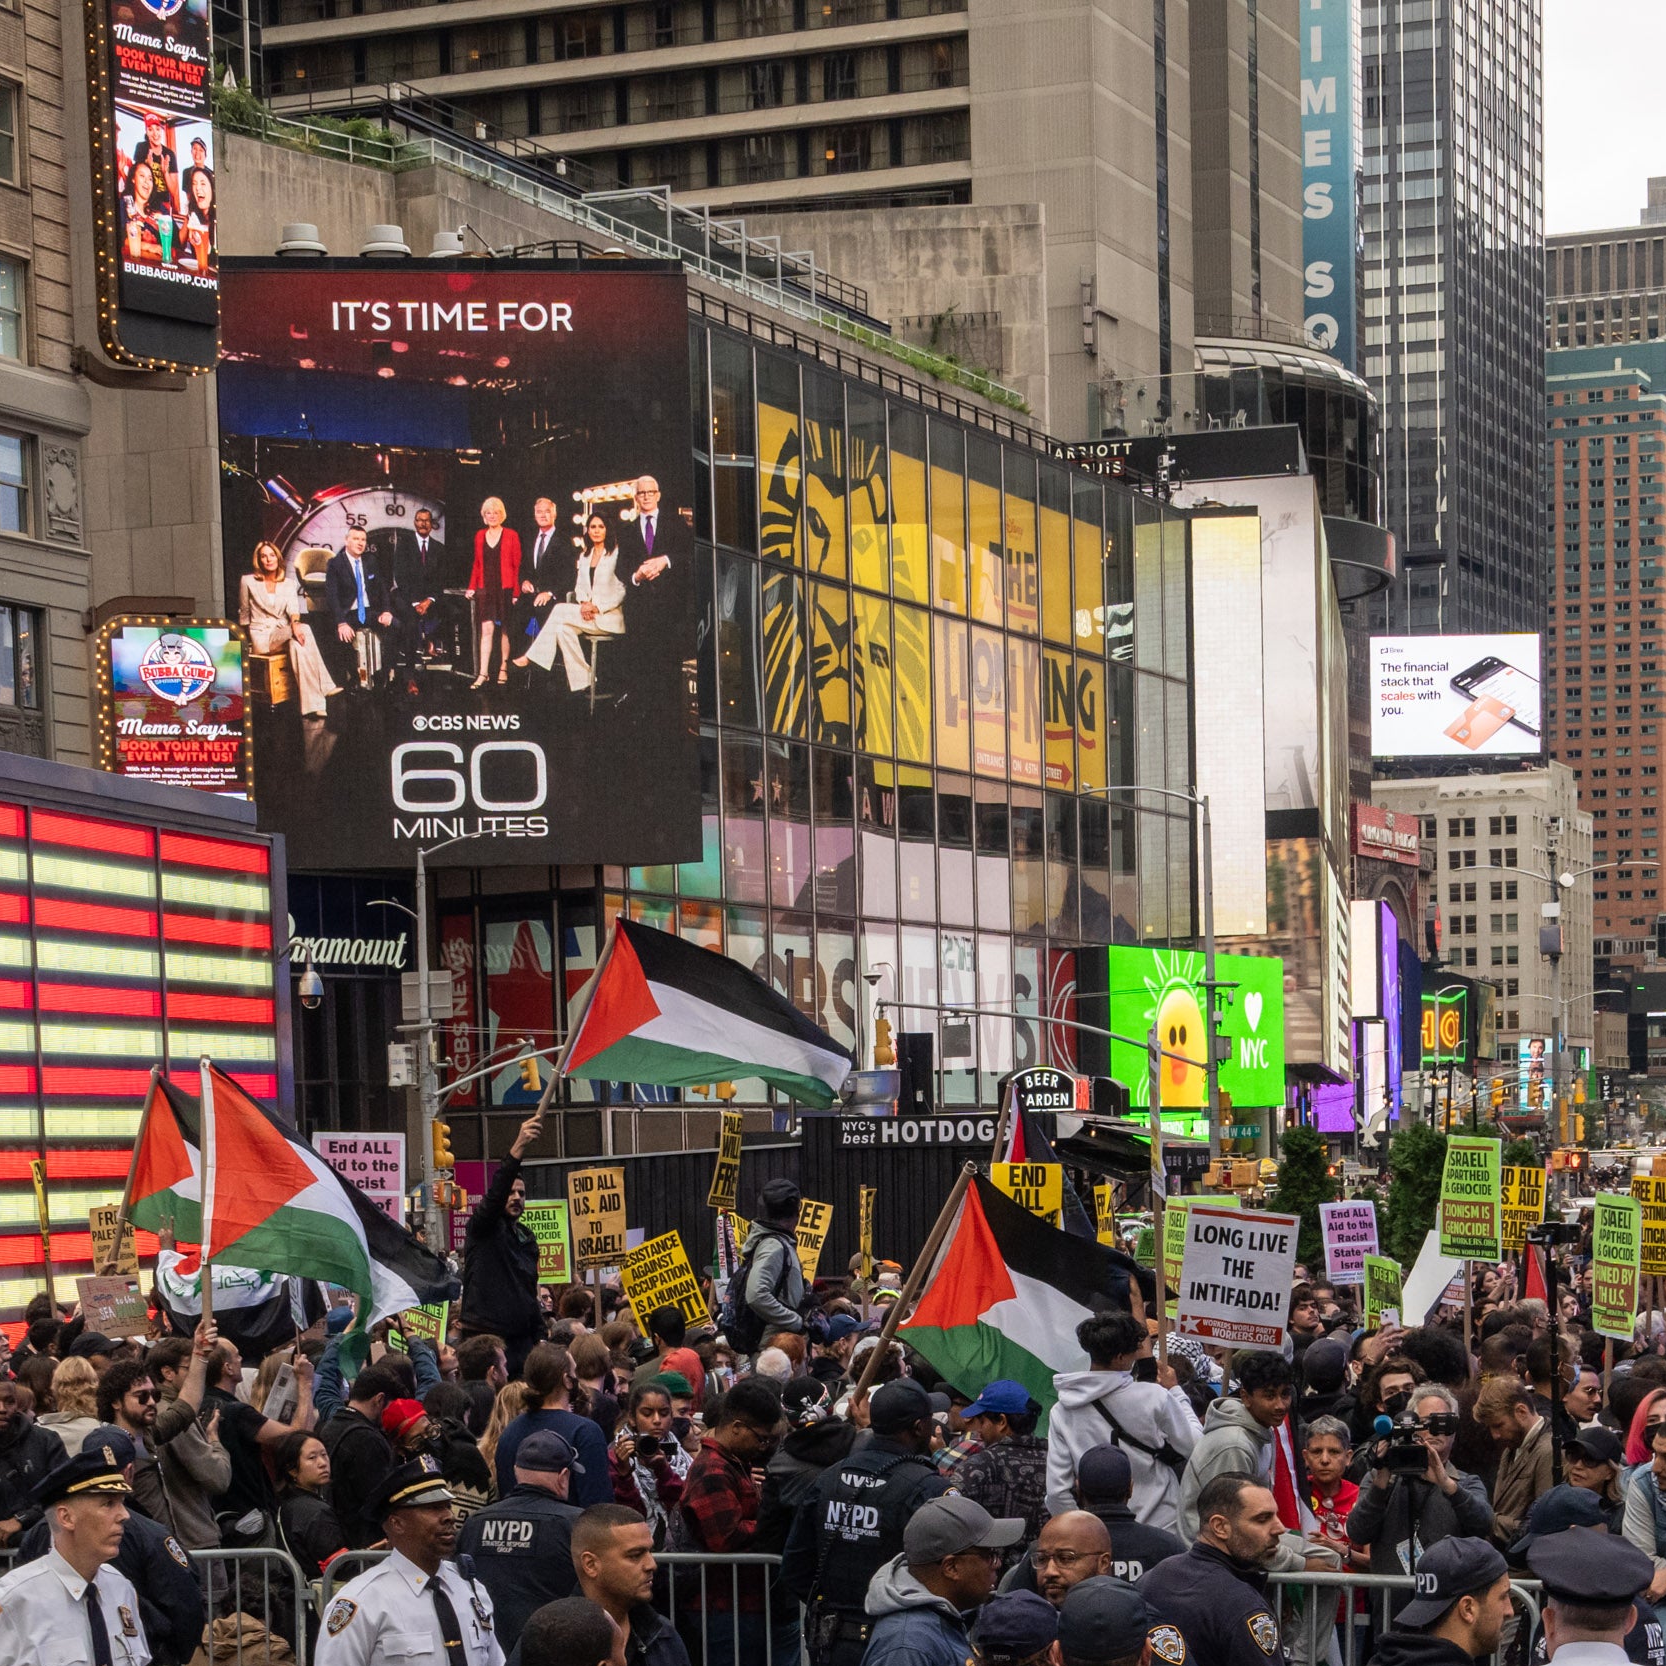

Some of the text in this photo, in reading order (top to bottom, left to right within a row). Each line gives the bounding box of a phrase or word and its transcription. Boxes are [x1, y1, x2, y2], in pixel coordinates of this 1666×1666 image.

[124, 262, 218, 290] BUBBAGUMP.COM
[332, 302, 573, 332] IT'S TIME FOR
[143, 664, 215, 680] BUBBA GUMP
[1381, 662, 1449, 672] The financial
[1381, 676, 1434, 687] stack that
[1381, 690, 1441, 701] scales with
[1381, 706, 1403, 717] you.
[117, 718, 181, 736] Mama
[467, 715, 521, 730] NEWS
[120, 741, 239, 752] BOOK YOUR NEXT
[127, 752, 233, 762] EVENT WITH US!
[391, 741, 547, 812] 60
[393, 816, 549, 839] MINUTES
[1239, 1036, 1271, 1070] NYC
[1025, 1074, 1059, 1089] BEER
[842, 1131, 875, 1144] best
[329, 1141, 393, 1154] End ALL
[1448, 1151, 1487, 1168] ISRAELI
[1009, 1164, 1047, 1187] END
[1446, 1169, 1490, 1182] APARTHEID
[1519, 1168, 1542, 1188] ALL
[573, 1174, 617, 1194] END ALL
[1451, 1183, 1492, 1196] GENOCIDE
[573, 1193, 621, 1216] U.S. AID
[1518, 1188, 1539, 1208] AID
[1330, 1209, 1369, 1218] End ALL
[1445, 1204, 1490, 1220] ZIONISM IS
[589, 1221, 603, 1234] TO
[1327, 1220, 1374, 1231] Aid the
[1445, 1221, 1490, 1236] GENOCIDE!
[1194, 1224, 1244, 1249] LONG
[1248, 1232, 1289, 1254] LIVE
[1337, 1232, 1368, 1243] Racist
[578, 1234, 623, 1258] ISRAEL!
[632, 1252, 675, 1282] AGAINST
[1221, 1256, 1255, 1280] THE
[627, 1262, 691, 1299] OCCUPATION
[1189, 1281, 1281, 1312] INTIFADA!
[1211, 1328, 1276, 1344] WORKERS.ORG
[482, 1520, 533, 1542] NYPD
